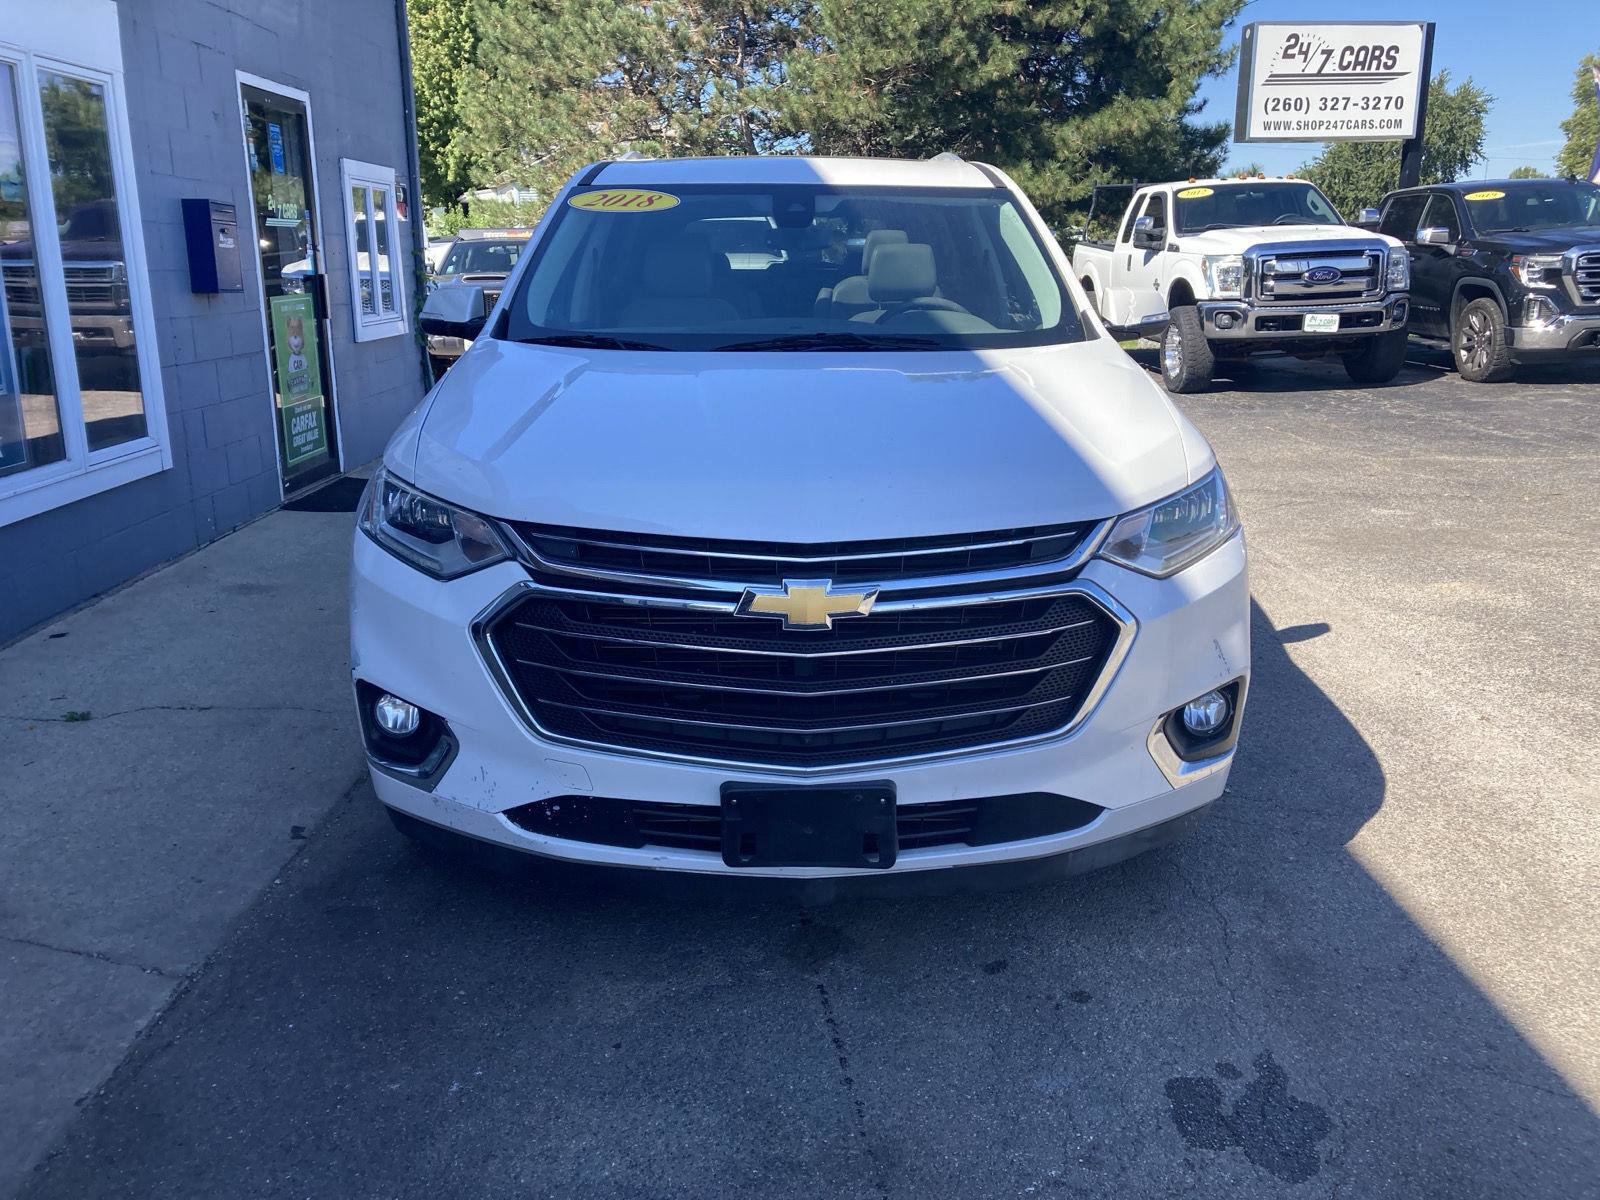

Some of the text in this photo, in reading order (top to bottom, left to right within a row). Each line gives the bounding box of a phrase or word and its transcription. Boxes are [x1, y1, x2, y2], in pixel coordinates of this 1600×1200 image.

[1281, 33, 1400, 74] 24/7 CARS
[1264, 96, 1405, 115] (260) 327-3270
[1263, 118, 1403, 131] WWW.SHOP247CARS.COM
[581, 193, 663, 208] 2018
[1312, 270, 1334, 281] Ford
[291, 411, 317, 435] CARFAX
[292, 428, 319, 448] GREAT VALUE
